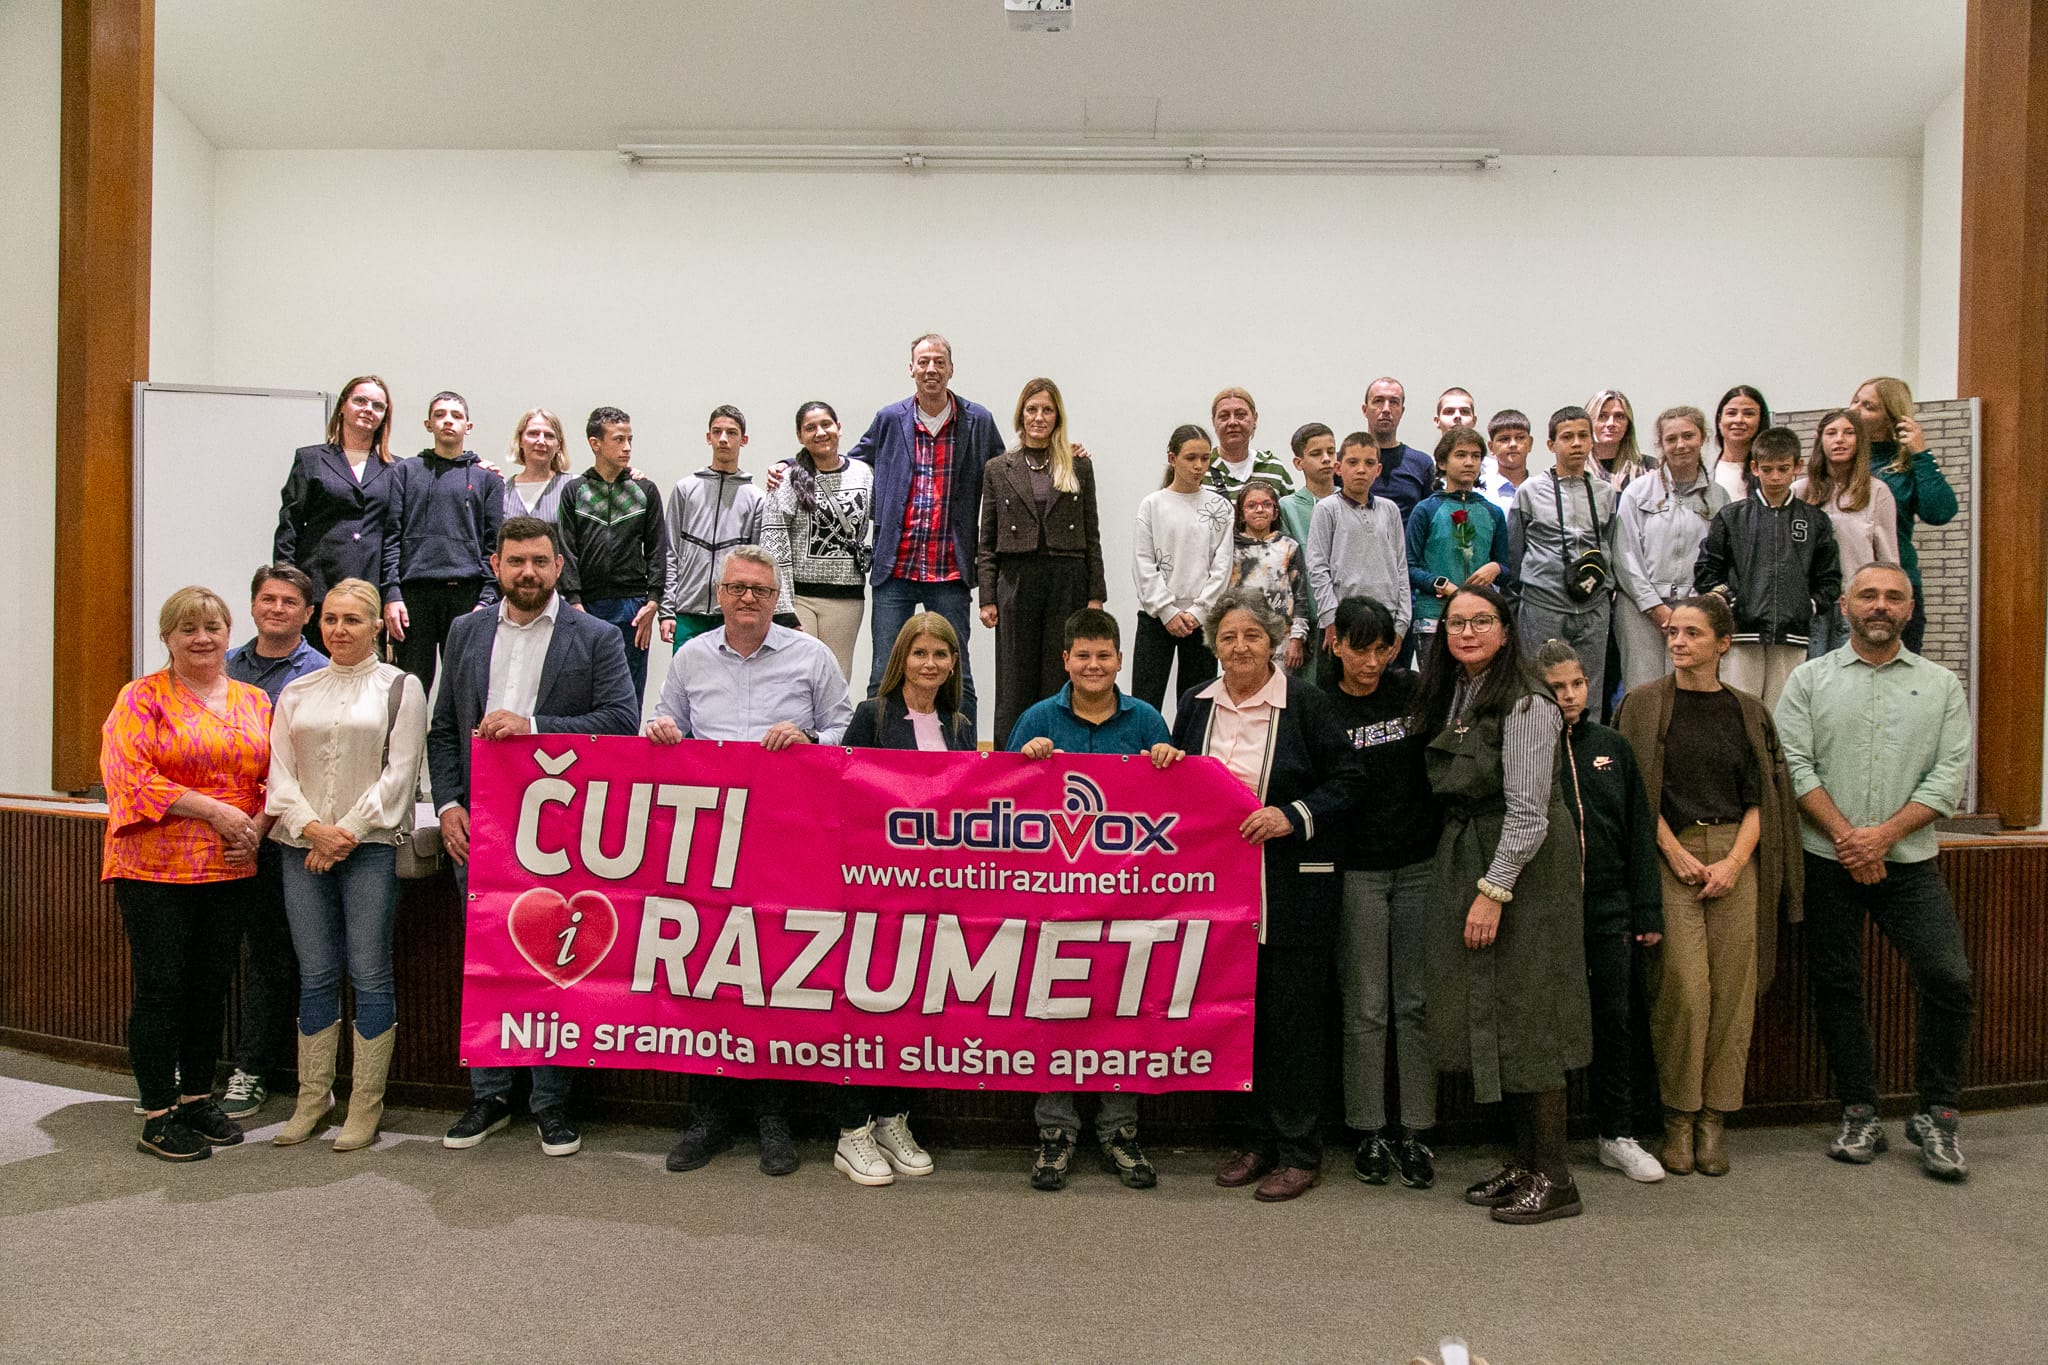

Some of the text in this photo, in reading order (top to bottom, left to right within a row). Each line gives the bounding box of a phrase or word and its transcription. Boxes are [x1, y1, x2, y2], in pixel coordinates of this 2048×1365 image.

[1791, 519, 1808, 542] S
[1579, 575, 1597, 595] A
[515, 748, 748, 889] ČUTI
[887, 799, 1179, 861] audiovox
[841, 862, 1215, 895] www.cutiirazumeti.com
[557, 911, 583, 967] i
[630, 896, 1210, 1020] RAZUMETI
[500, 1012, 1212, 1084] Nije sramota nositi slušne aparate
